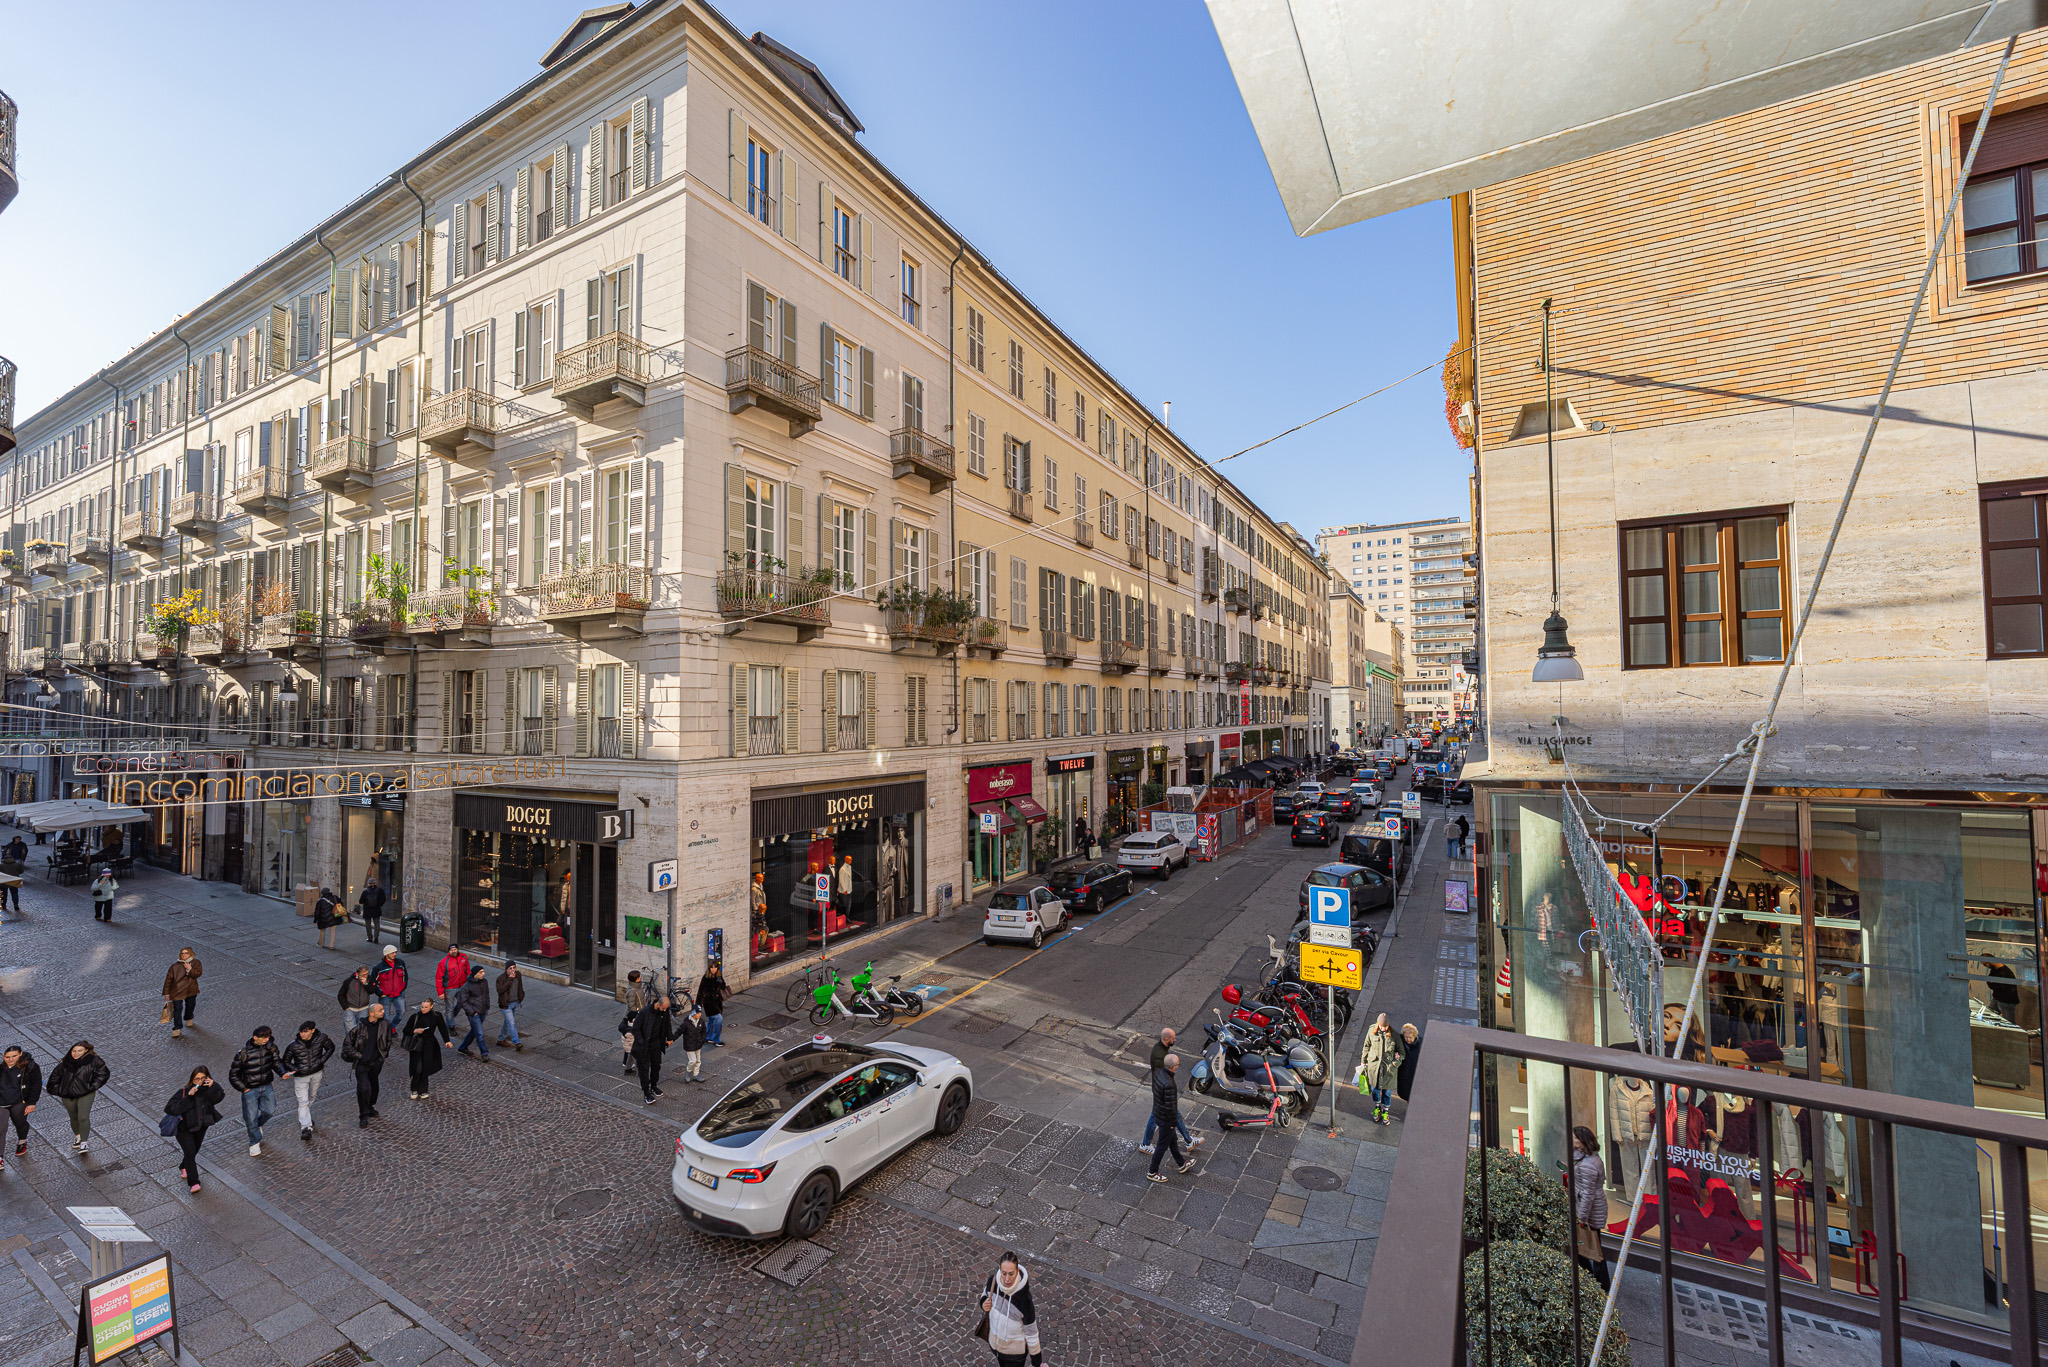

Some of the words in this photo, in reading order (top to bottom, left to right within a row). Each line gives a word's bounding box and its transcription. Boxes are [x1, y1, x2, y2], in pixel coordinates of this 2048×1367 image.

[117, 738, 188, 753] bambini
[1517, 736, 1532, 745] VIA
[79, 756, 158, 773] come
[1059, 758, 1085, 771] TWELVE
[113, 769, 384, 806] incominciarono
[394, 769, 409, 790] a
[416, 762, 506, 788] saltare
[512, 757, 566, 780] fuori
[989, 778, 1014, 789] noberasco
[826, 794, 874, 815] BOGGI
[506, 805, 552, 826] BOGGI
[831, 812, 869, 824] MILANO
[511, 825, 547, 835] MILANO
[602, 815, 622, 839] B
[1317, 890, 1343, 922] P
[1693, 1158, 1761, 1181] HOLIDAYS
[1718, 1154, 1749, 1169] YOU
[110, 1267, 148, 1287] MAGNO
[132, 1277, 166, 1295] PIZZERIA
[133, 1282, 167, 1300] APERTA
[93, 1293, 129, 1312] CUCINA
[93, 1298, 129, 1318] APERTA
[134, 1301, 168, 1320] PIZZERIA
[135, 1305, 170, 1326] OPEN
[95, 1318, 131, 1338] KITCHEN
[96, 1323, 132, 1344] OPEN
